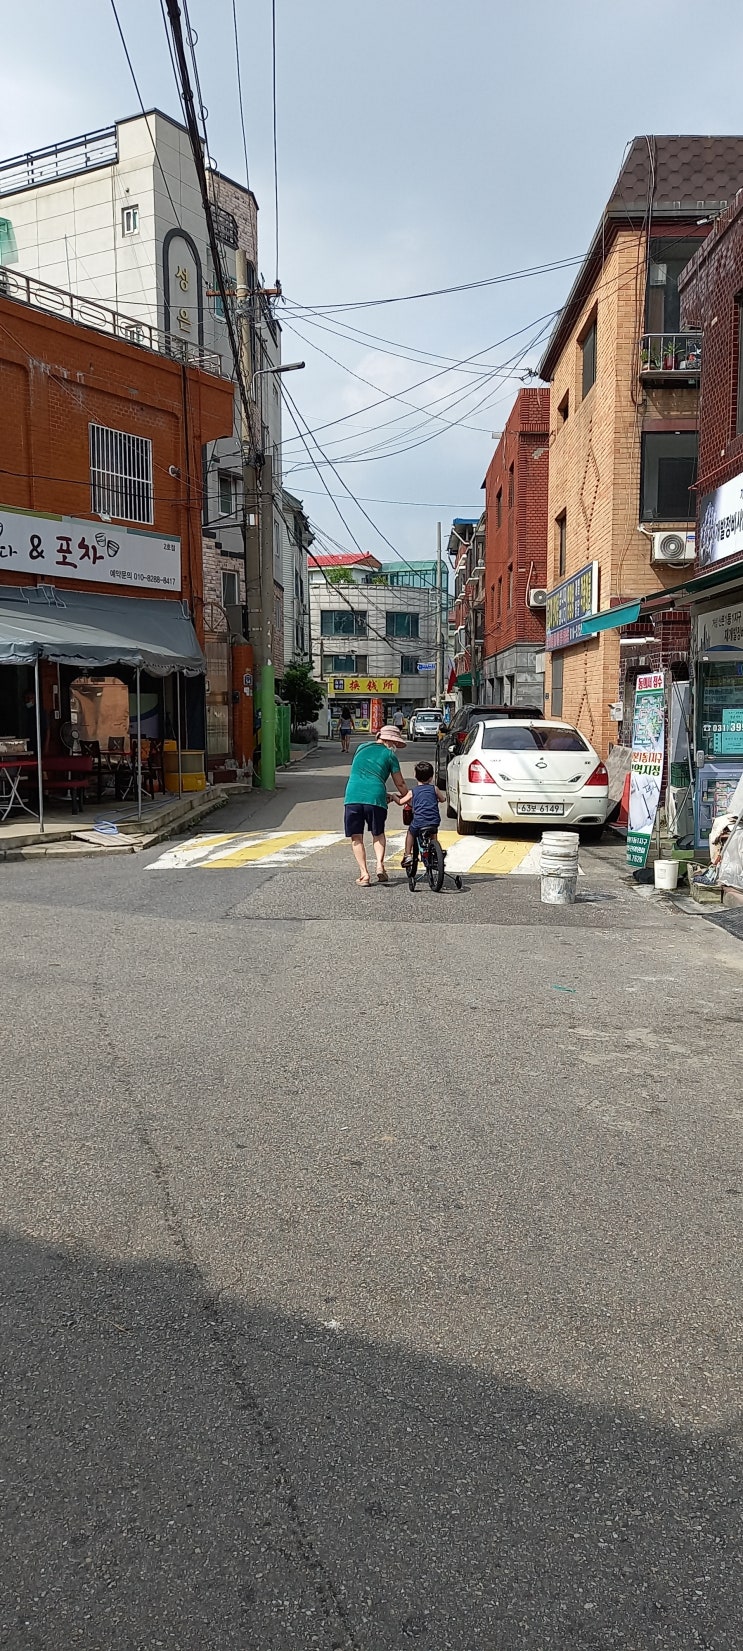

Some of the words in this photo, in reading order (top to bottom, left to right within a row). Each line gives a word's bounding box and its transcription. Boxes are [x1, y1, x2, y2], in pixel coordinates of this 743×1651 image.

[175, 265, 192, 333] 성은
[29, 534, 45, 560] &
[55, 536, 105, 569] 포차
[109, 569, 133, 580] 예약문의
[631, 764, 661, 776] 역지정
[540, 804, 559, 813] 6149
